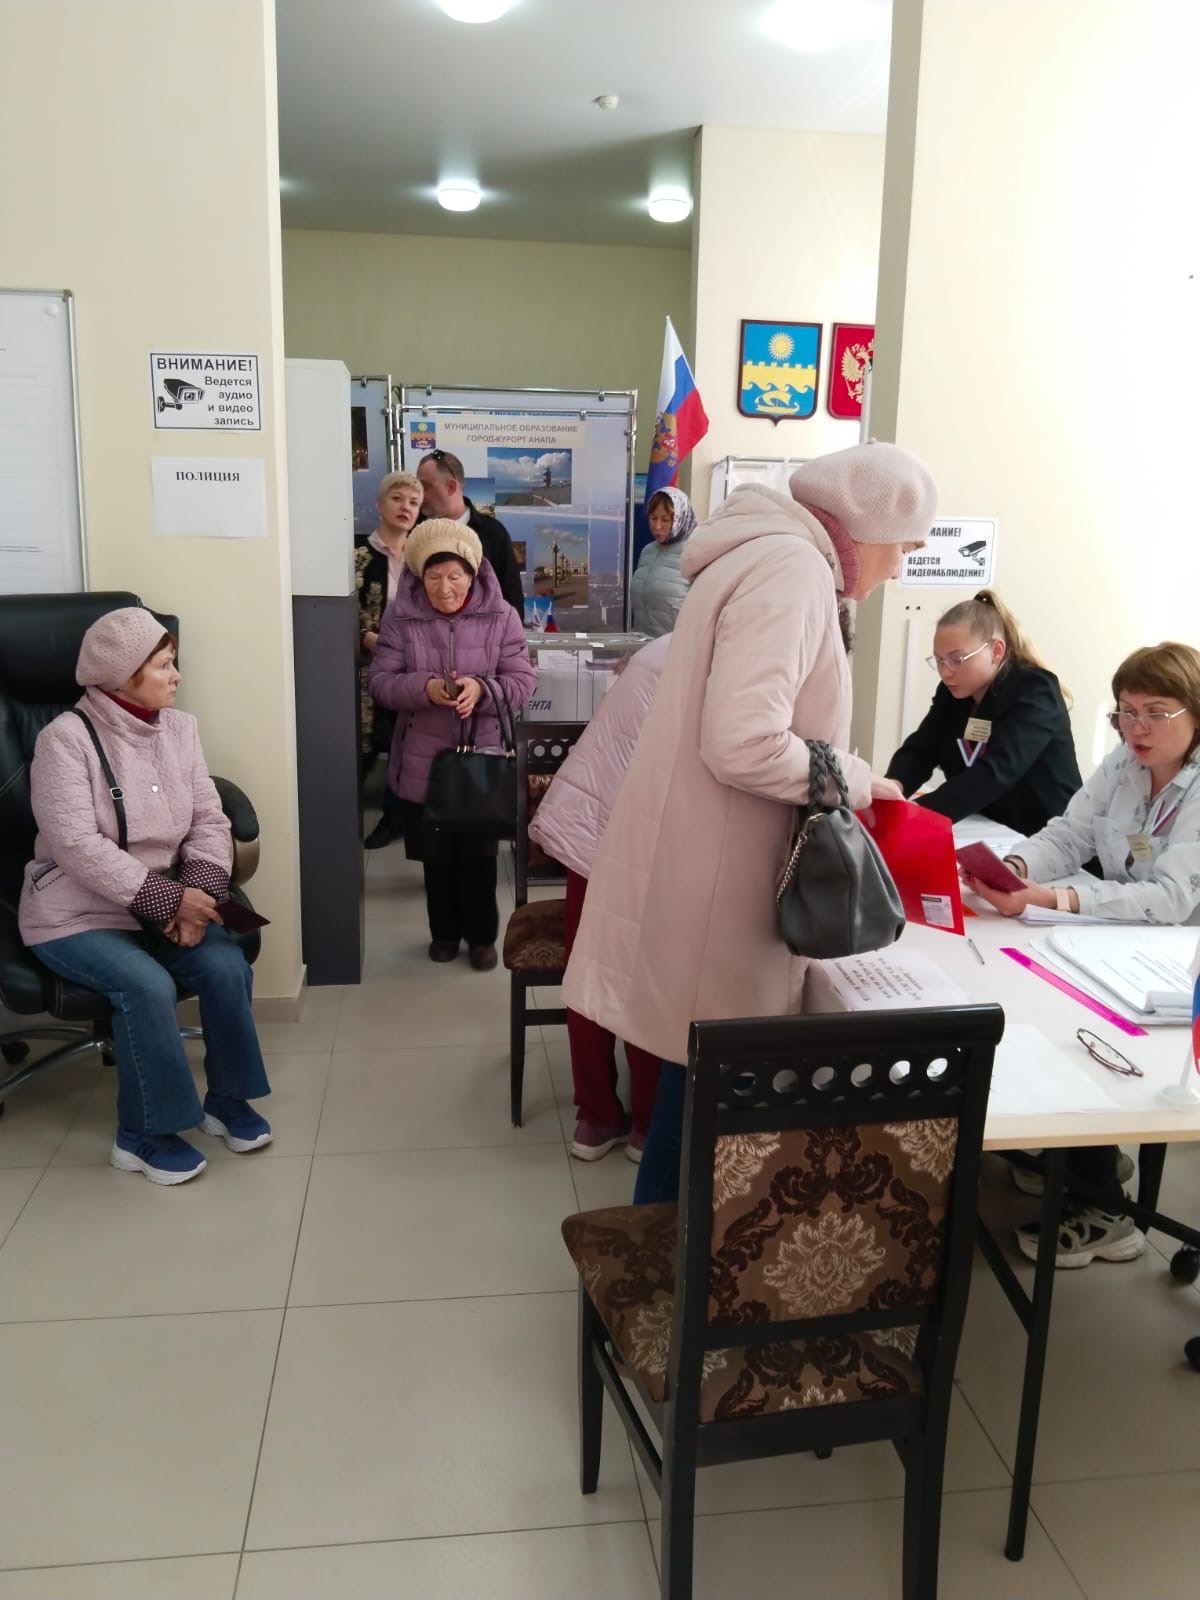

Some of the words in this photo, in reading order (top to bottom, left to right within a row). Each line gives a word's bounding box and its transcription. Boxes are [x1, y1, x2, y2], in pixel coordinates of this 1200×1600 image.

[157, 357, 253, 372] ВНИМАНИЕ!
[204, 376, 252, 387] Ведется
[218, 391, 253, 401] аудио
[207, 405, 215, 413] и
[218, 404, 254, 414] видео
[213, 417, 254, 426] запись
[444, 423, 517, 433] МУНИЦИПАЛЬНОЕ
[519, 424, 578, 433] ОБРАЗОВАНИЕ
[467, 435, 527, 445] ГОРОД-КУРОРТ
[529, 436, 557, 445] АНАПА
[175, 471, 241, 483] ПОЛИЦИЯ
[928, 527, 962, 537] МАНИЕ!
[907, 557, 941, 565] ВЕДЕТСЯ
[906, 568, 985, 577] ВИДЕОНАБЛЮДЕНИЕ!
